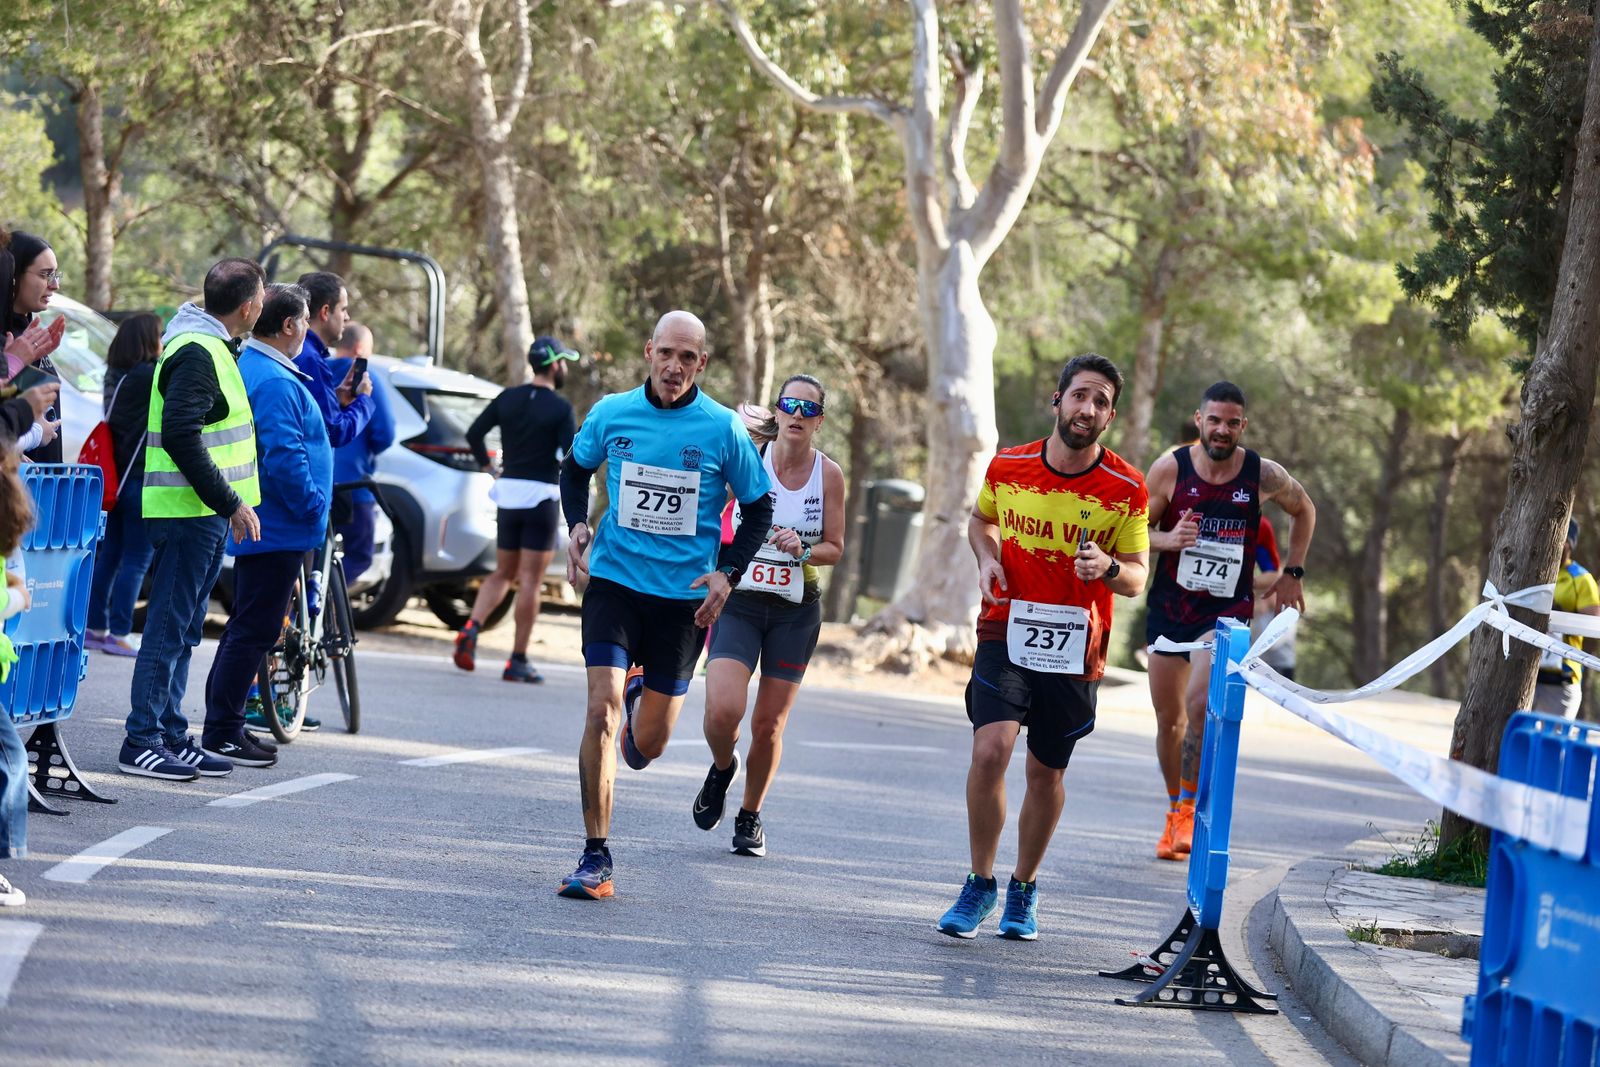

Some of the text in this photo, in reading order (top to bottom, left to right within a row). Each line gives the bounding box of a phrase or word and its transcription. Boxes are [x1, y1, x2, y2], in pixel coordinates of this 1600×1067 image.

[636, 489, 682, 514] 279
[752, 564, 791, 586] 613
[1192, 559, 1228, 580] 174
[1024, 627, 1071, 651] 237
